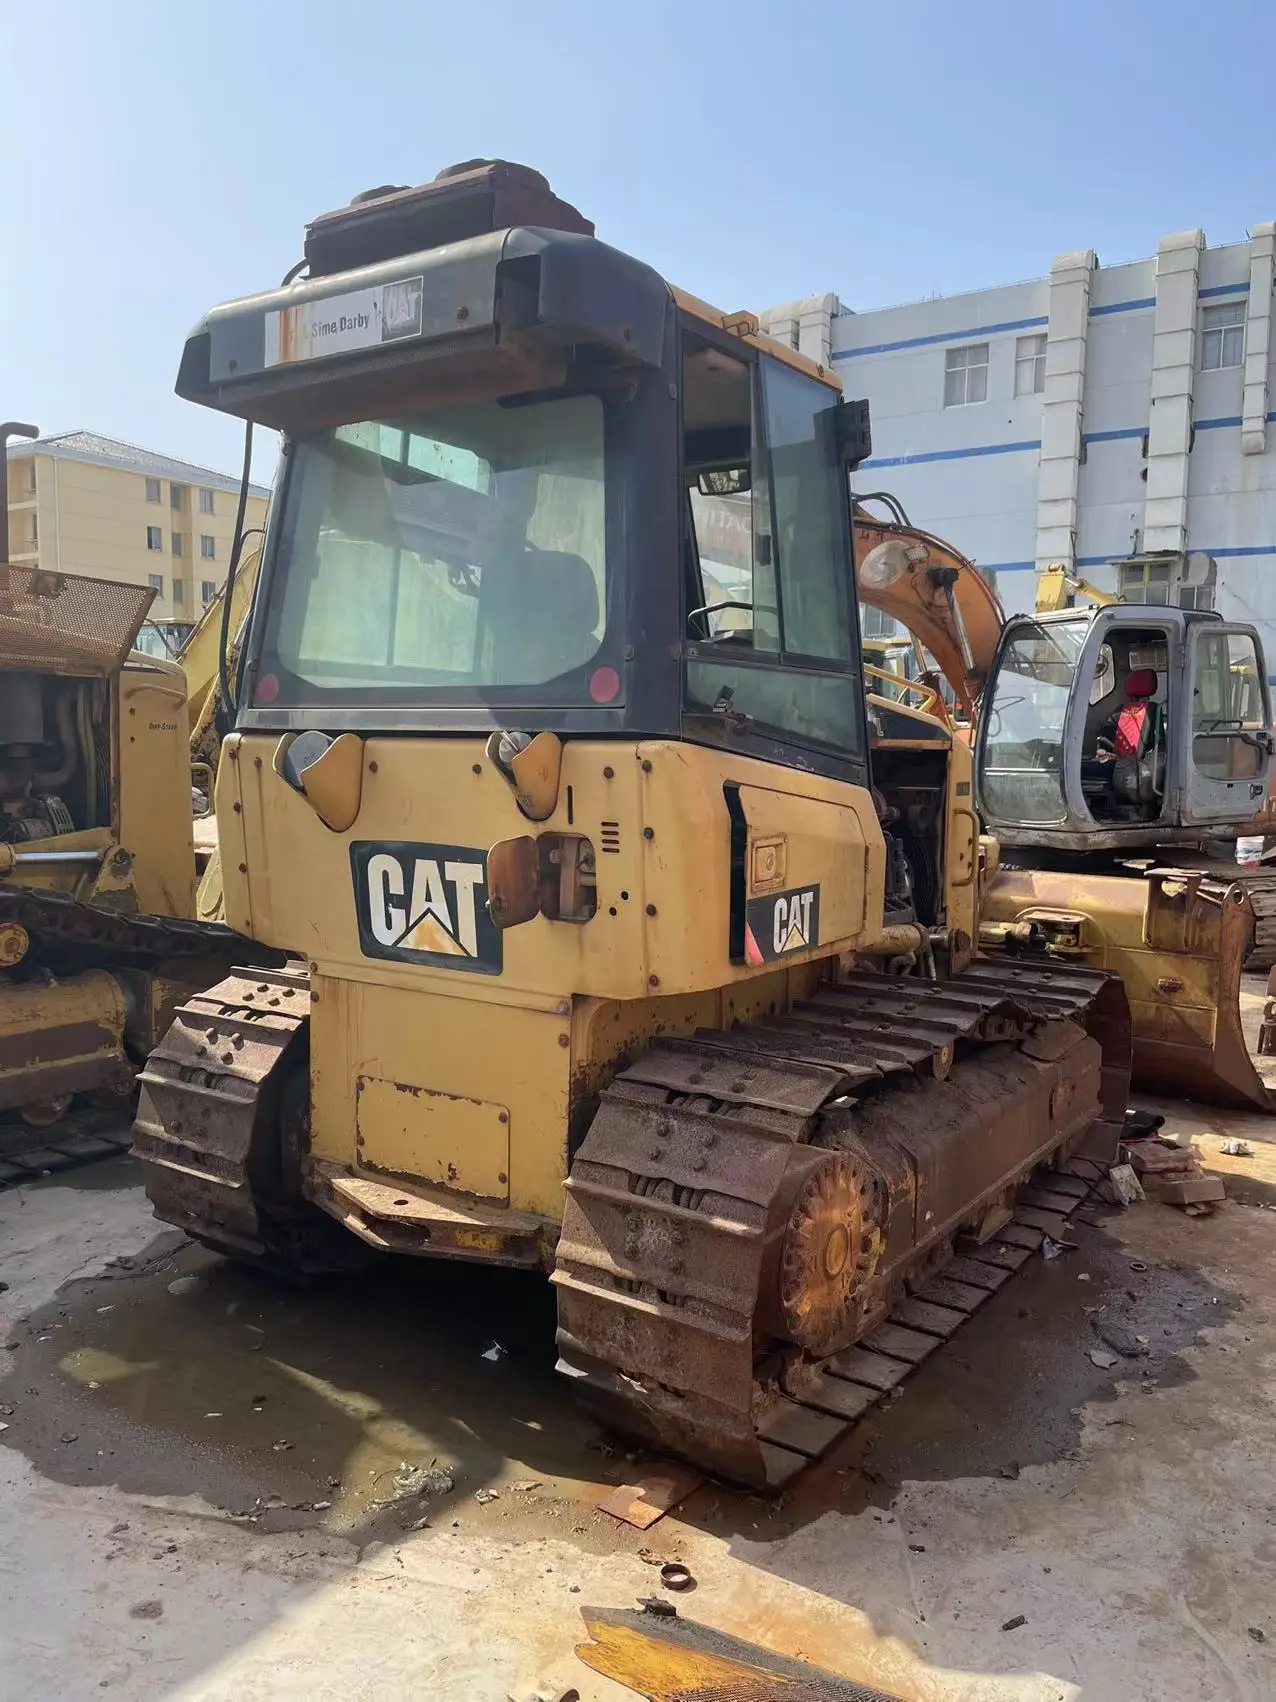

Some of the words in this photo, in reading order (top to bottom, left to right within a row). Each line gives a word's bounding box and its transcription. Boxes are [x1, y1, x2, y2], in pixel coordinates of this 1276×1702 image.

[311, 321, 337, 338] Sime
[339, 312, 370, 332] Darby
[367, 853, 484, 958] CAT
[773, 891, 814, 954] CAT
